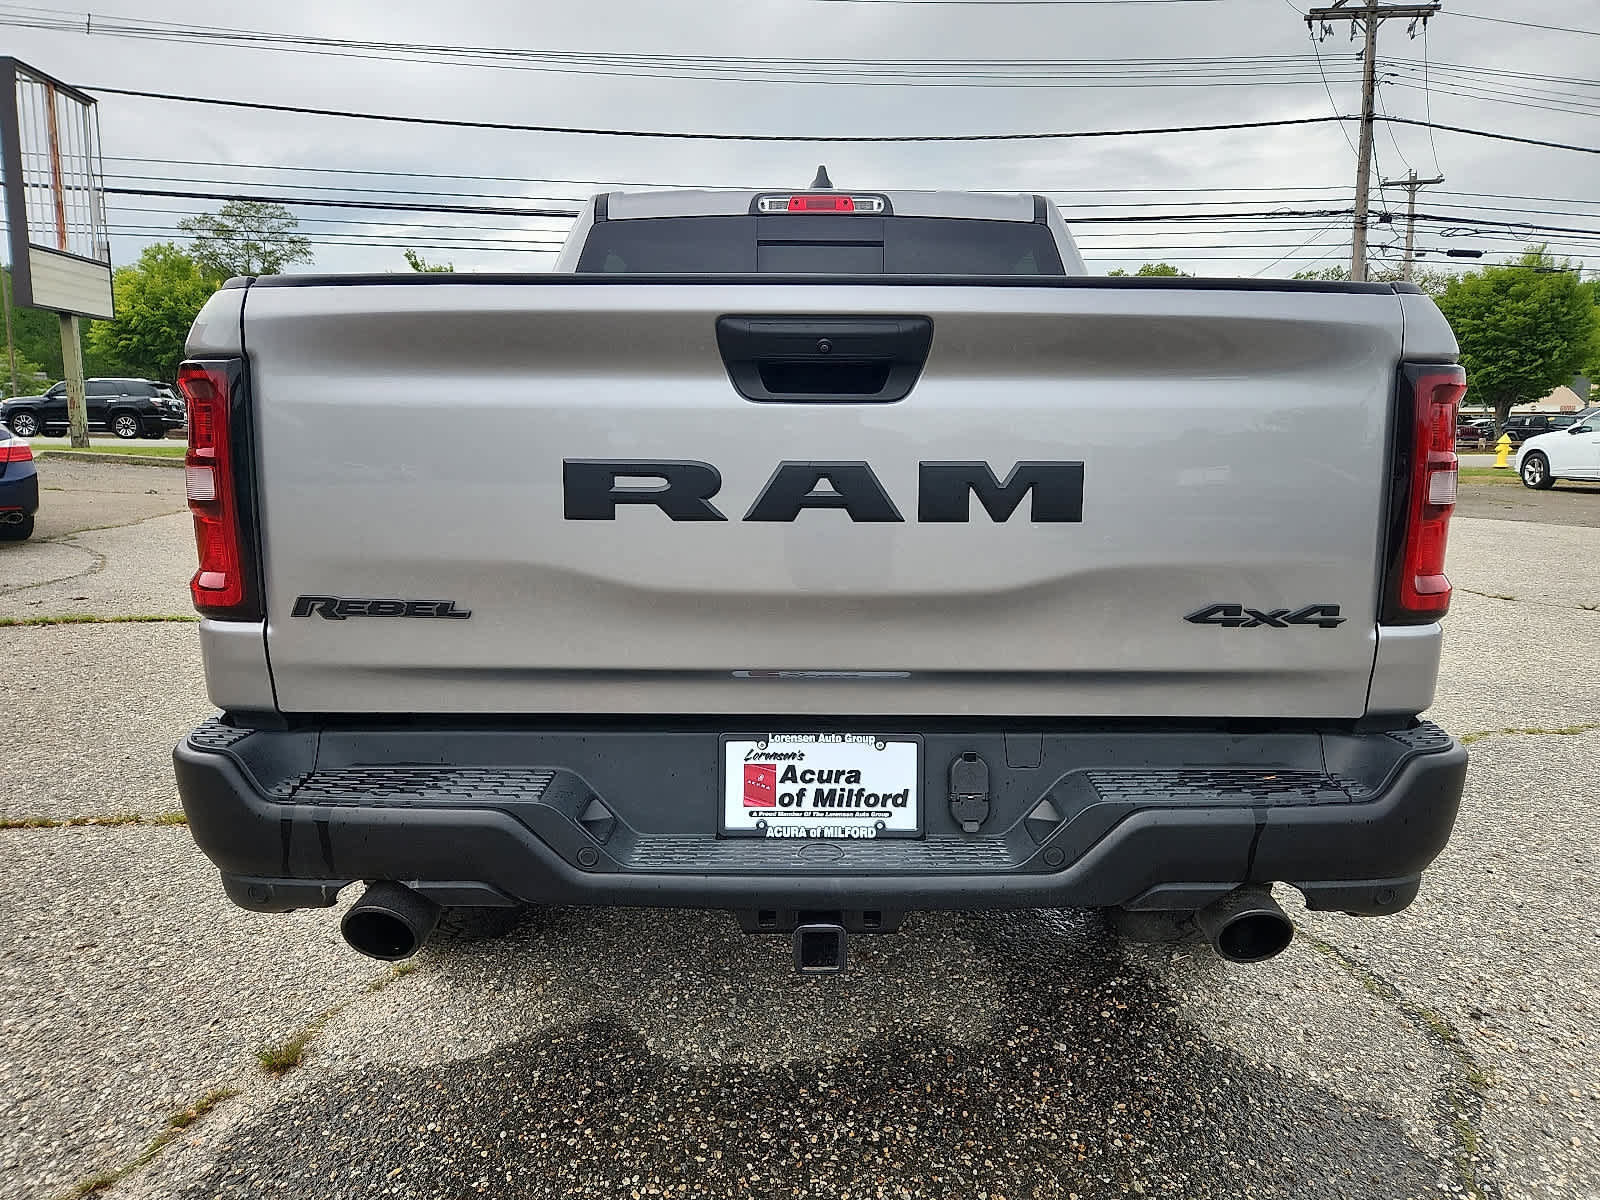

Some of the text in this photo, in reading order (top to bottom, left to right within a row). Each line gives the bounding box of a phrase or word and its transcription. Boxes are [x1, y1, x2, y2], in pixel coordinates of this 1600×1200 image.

[563, 458, 1084, 522] RAM
[769, 733, 875, 746] Lorensen Auto Group
[744, 748, 805, 762] Lorensen's
[779, 765, 861, 784] Acura
[778, 788, 910, 808] of Milford
[766, 826, 877, 838] ACURA of MILFORD
